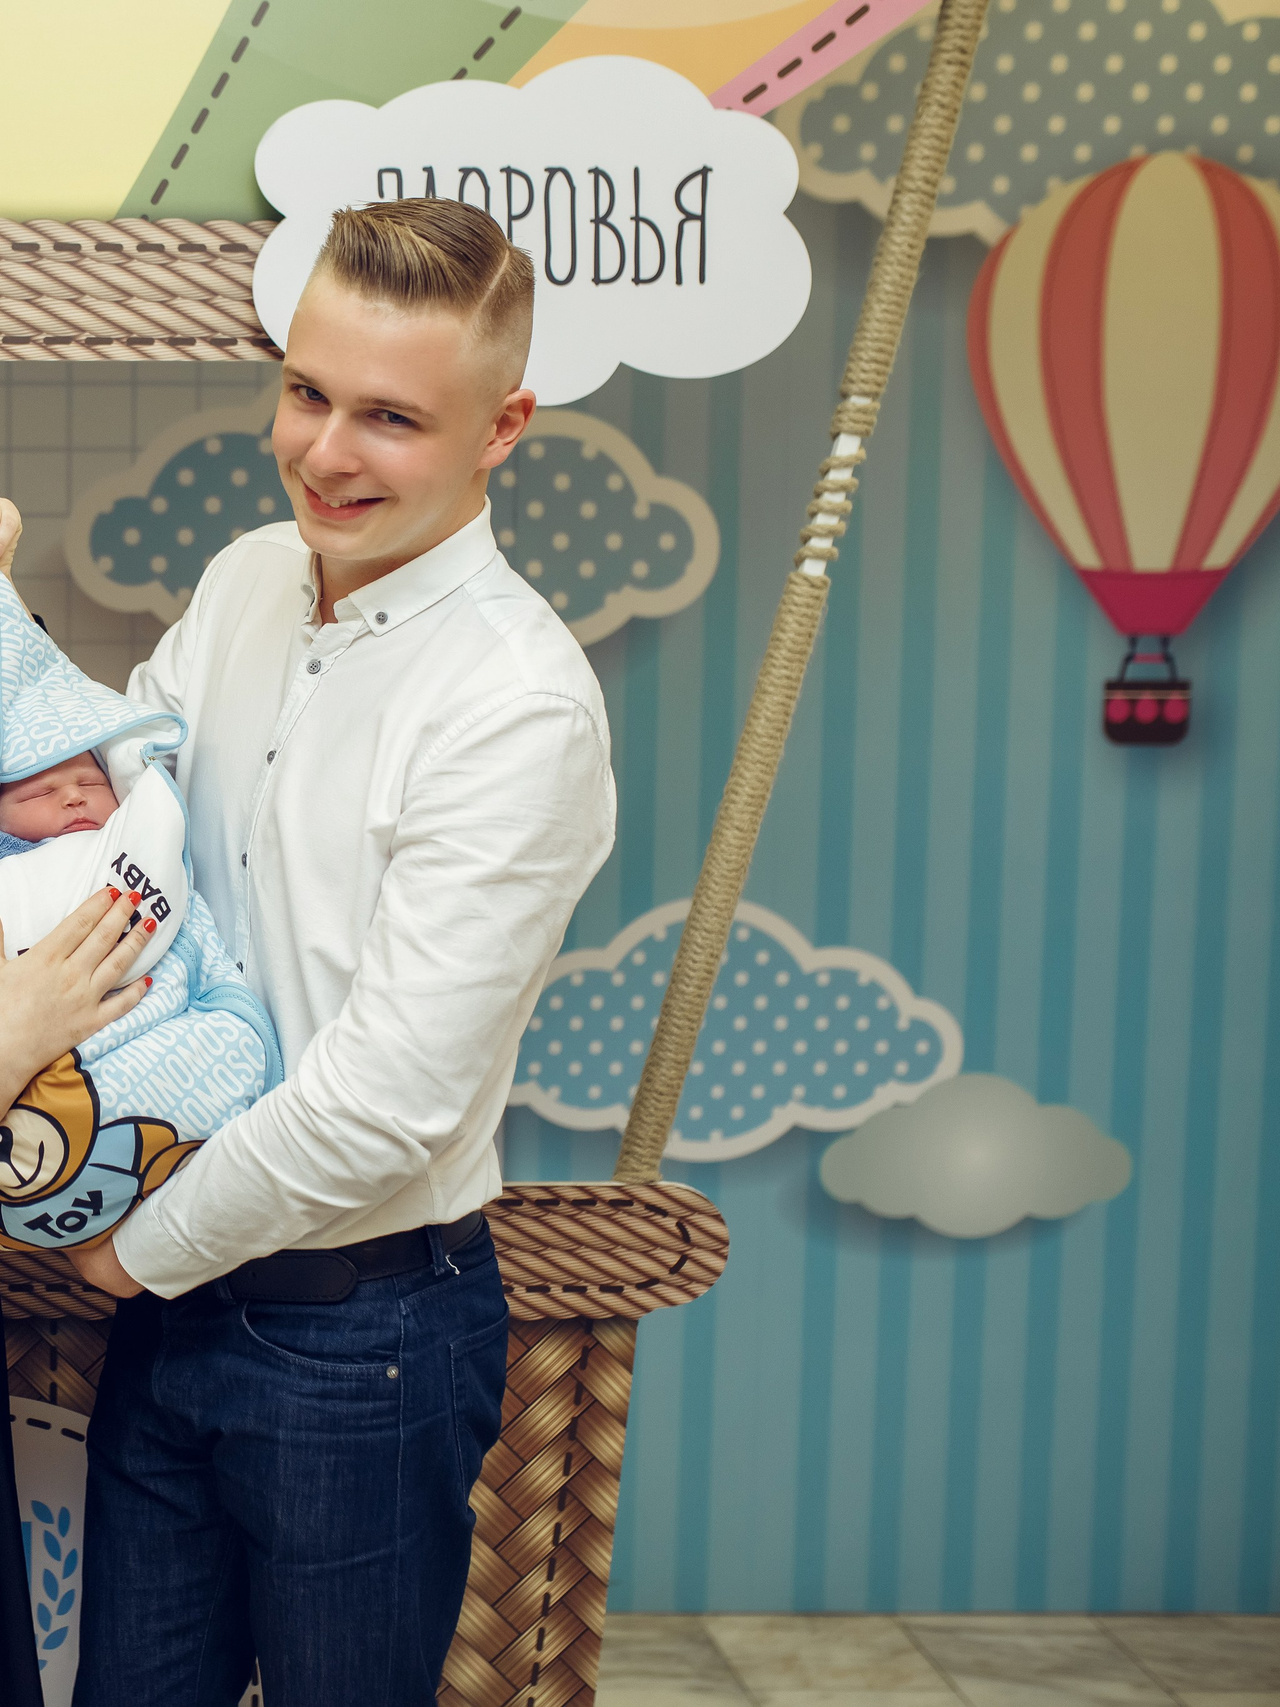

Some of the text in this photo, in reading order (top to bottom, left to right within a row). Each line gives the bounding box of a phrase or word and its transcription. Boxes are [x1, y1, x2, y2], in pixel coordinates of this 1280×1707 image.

[377, 165, 713, 286] РОВЬЯ
[110, 851, 172, 924] BABY
[22, 1189, 104, 1240] TOY
